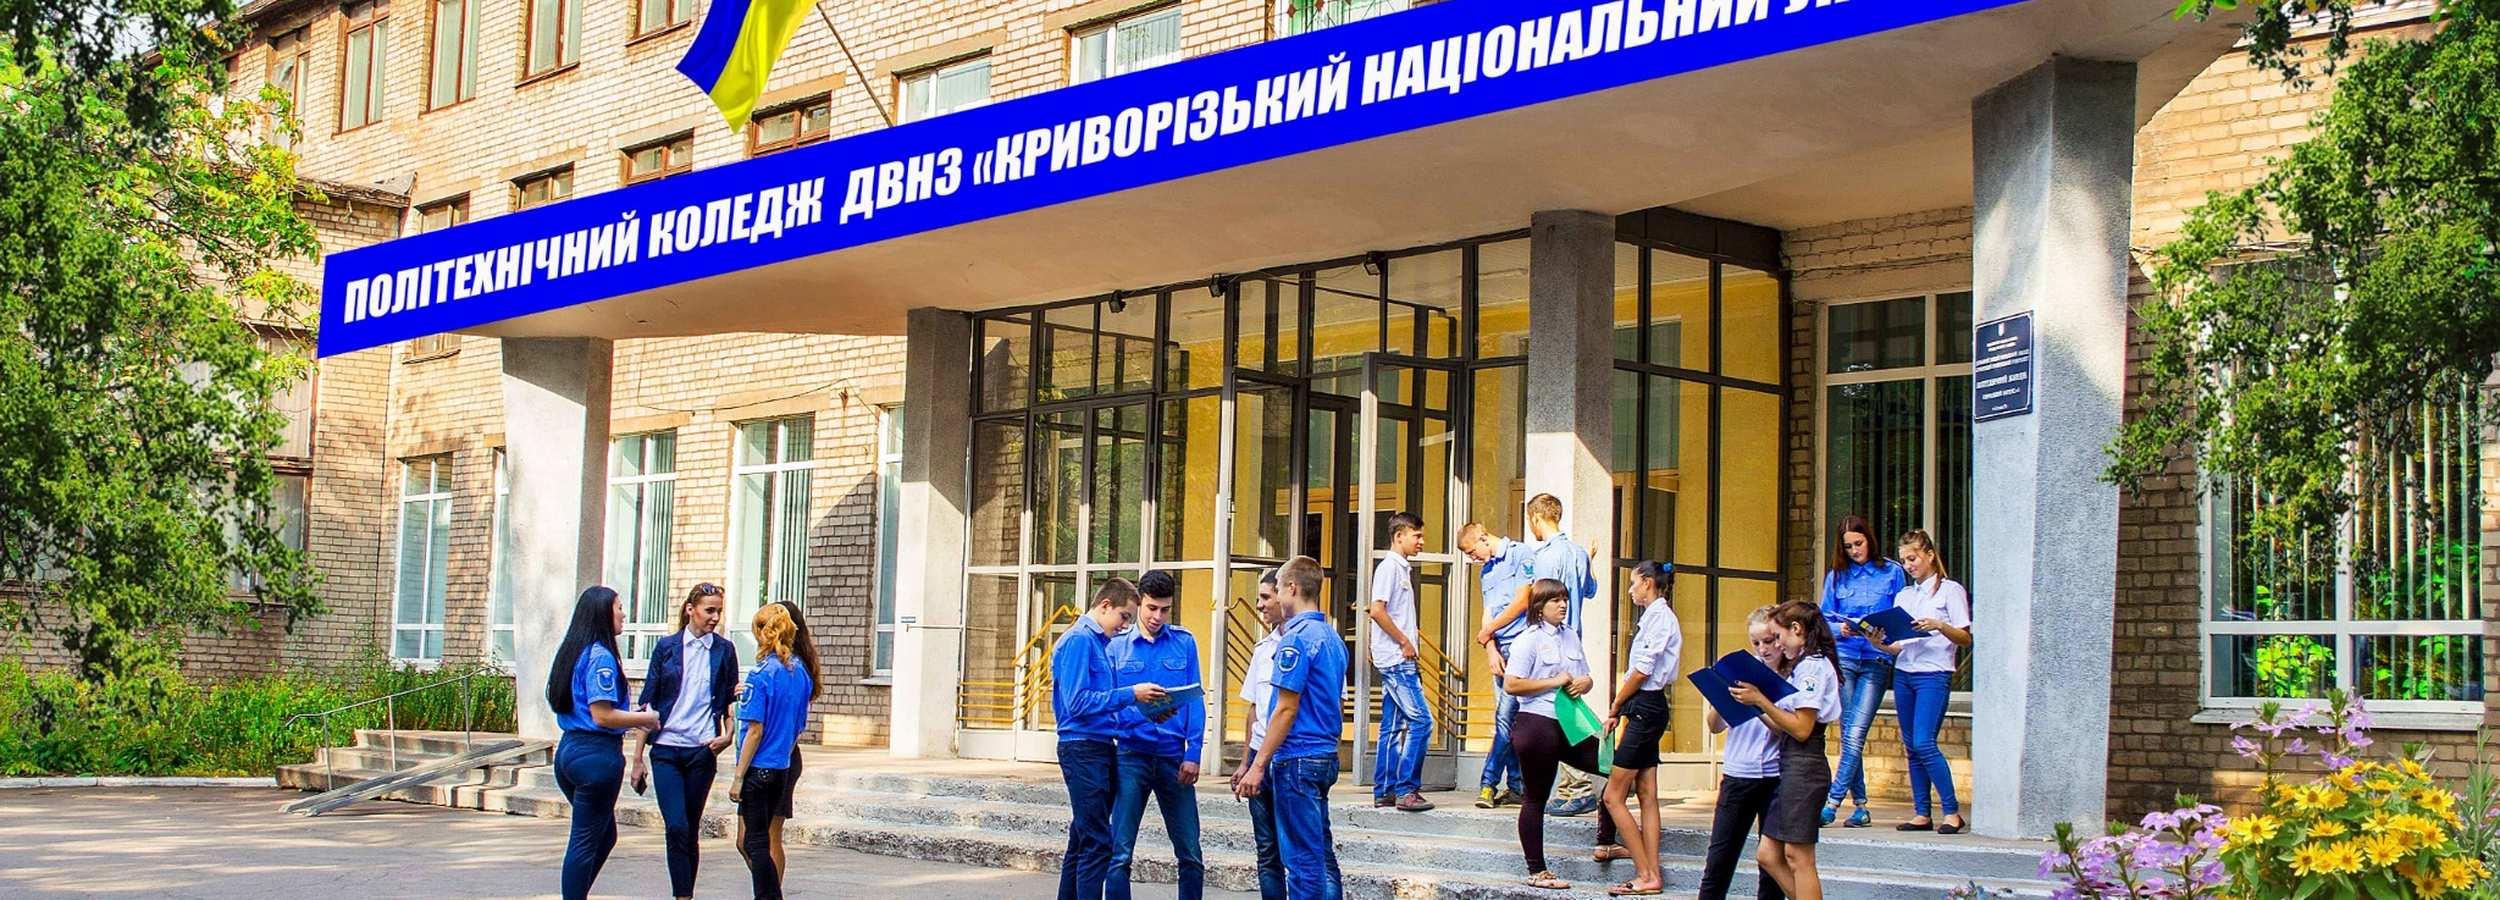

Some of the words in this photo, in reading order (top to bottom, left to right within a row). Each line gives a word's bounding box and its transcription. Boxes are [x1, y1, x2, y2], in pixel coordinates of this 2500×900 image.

[343, 209, 641, 324] ПОЛІТЕХНІЧНИЙ
[647, 176, 825, 259] КОЛЕДЖ
[839, 147, 963, 225] ДВНЗ
[972, 51, 1351, 186] «КРИВОРІЗЬКИЙ
